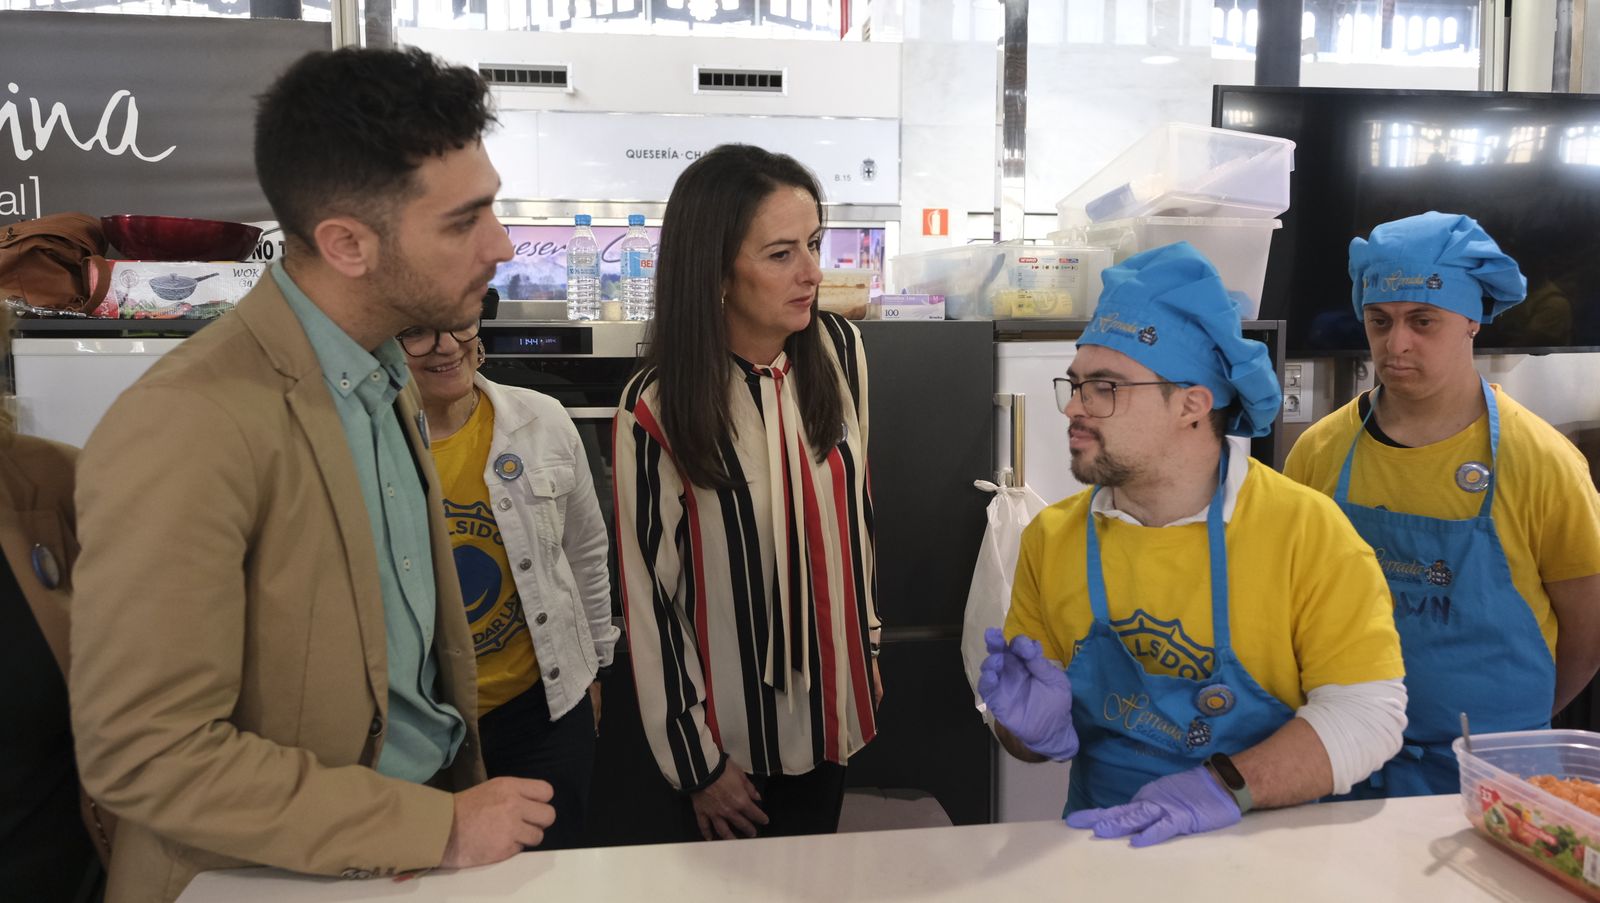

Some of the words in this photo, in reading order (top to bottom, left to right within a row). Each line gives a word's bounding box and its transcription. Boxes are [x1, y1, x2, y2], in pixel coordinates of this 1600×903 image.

[0, 82, 176, 162] ina
[252, 239, 274, 260] NO
[278, 240, 287, 258] T
[232, 268, 260, 279] WOK
[885, 309, 899, 317] 100
